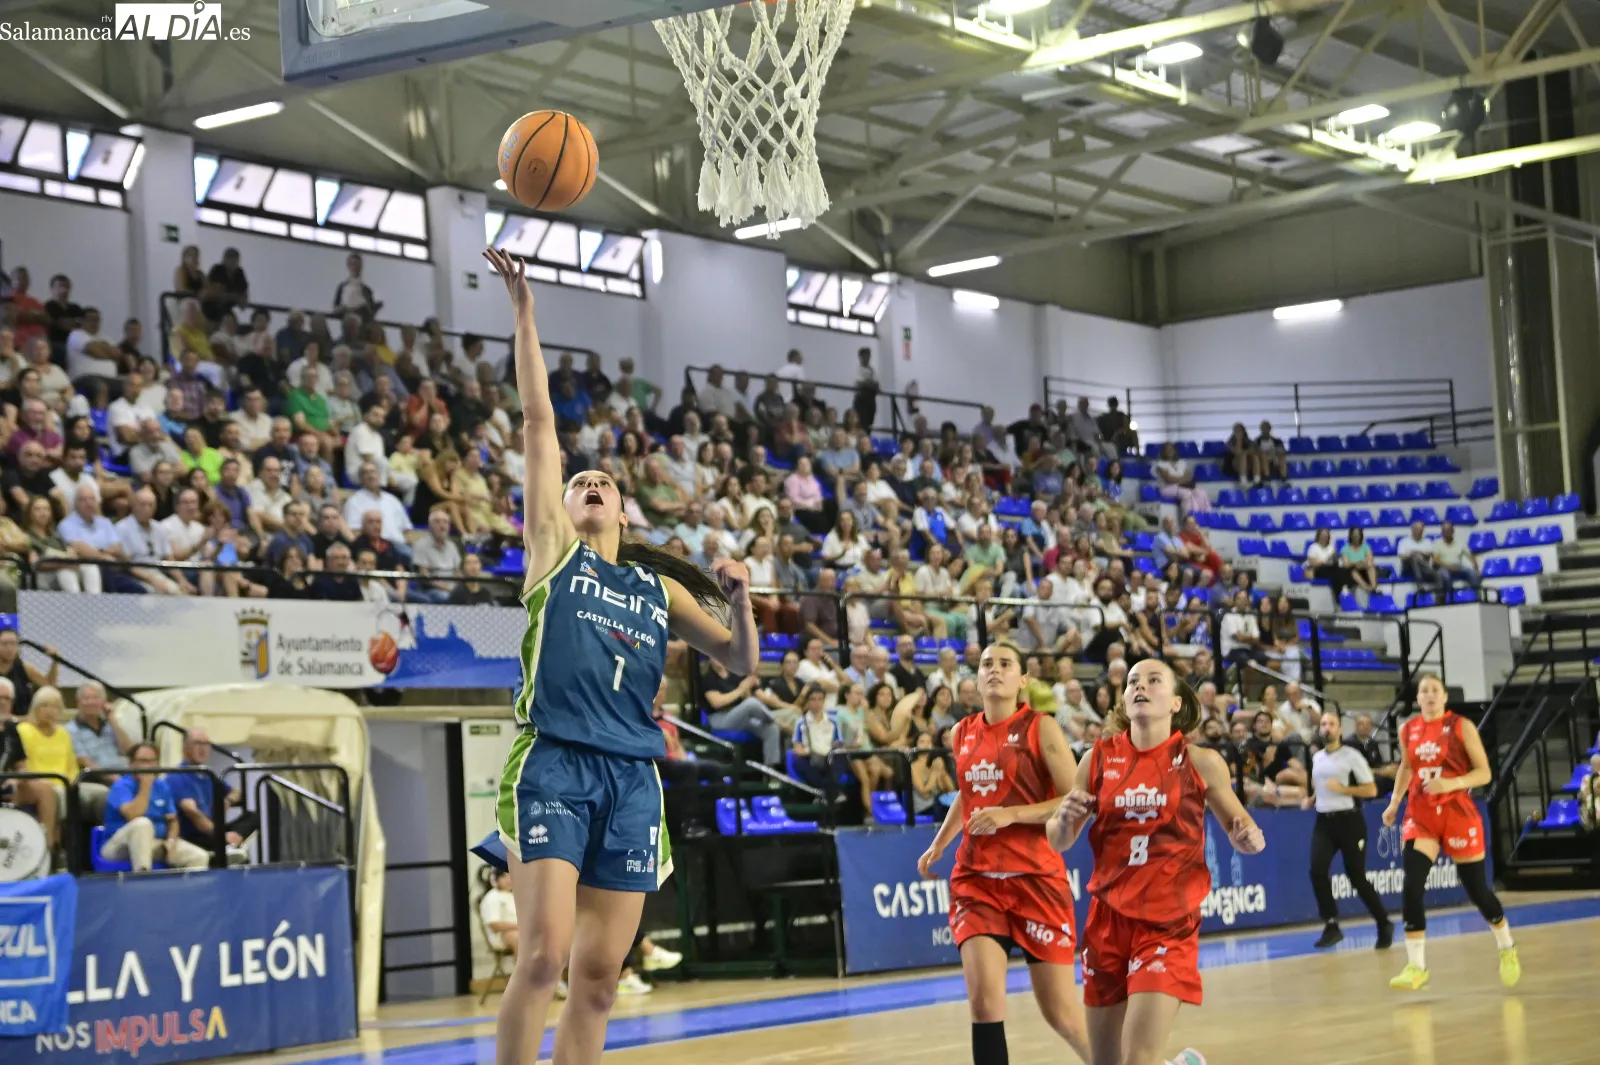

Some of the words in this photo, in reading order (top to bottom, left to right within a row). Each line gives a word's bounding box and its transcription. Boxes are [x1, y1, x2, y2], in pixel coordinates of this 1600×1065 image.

[276, 633, 363, 655] Ayuntamiento
[576, 610, 625, 633] CASTILLA
[626, 626, 634, 636] Y
[635, 630, 656, 648] LEÓN
[276, 657, 293, 676] de
[297, 657, 364, 676] Salamanca
[612, 655, 626, 692] 1
[1128, 835, 1149, 866] 8
[932, 926, 957, 948] NO
[169, 943, 201, 1003] Y
[219, 920, 326, 988] LEÓN
[35, 1020, 93, 1054] NOS
[94, 1005, 228, 1058] IMPULSA
